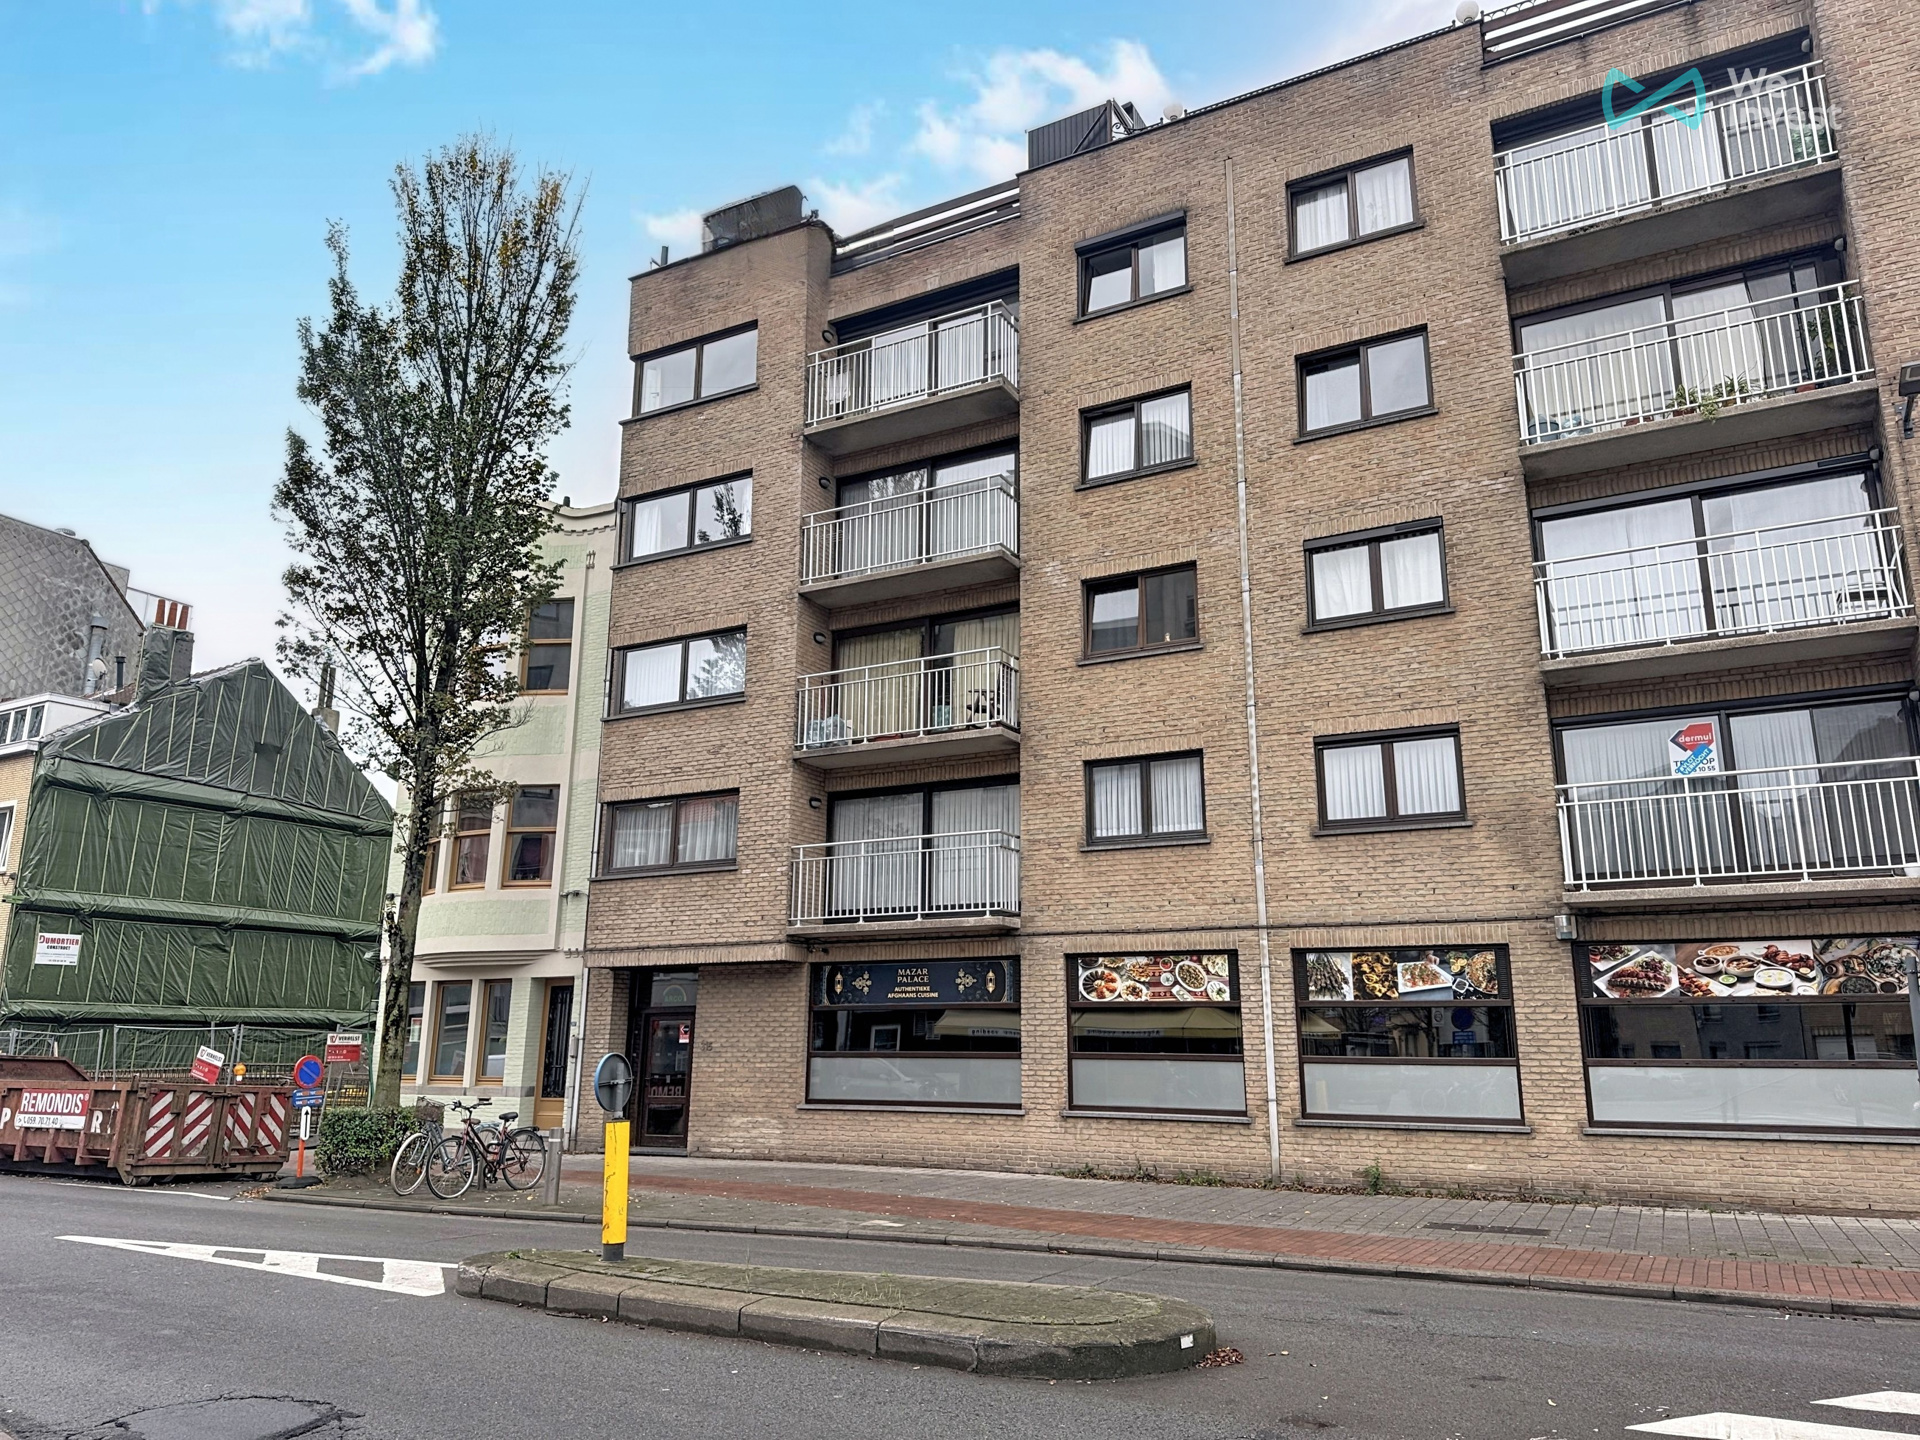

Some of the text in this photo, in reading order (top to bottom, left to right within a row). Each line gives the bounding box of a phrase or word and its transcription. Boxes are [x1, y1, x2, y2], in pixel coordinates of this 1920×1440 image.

[1679, 732, 1712, 742] dermul
[39, 935, 79, 946] DUMORTIER
[897, 968, 929, 976] MAZAR
